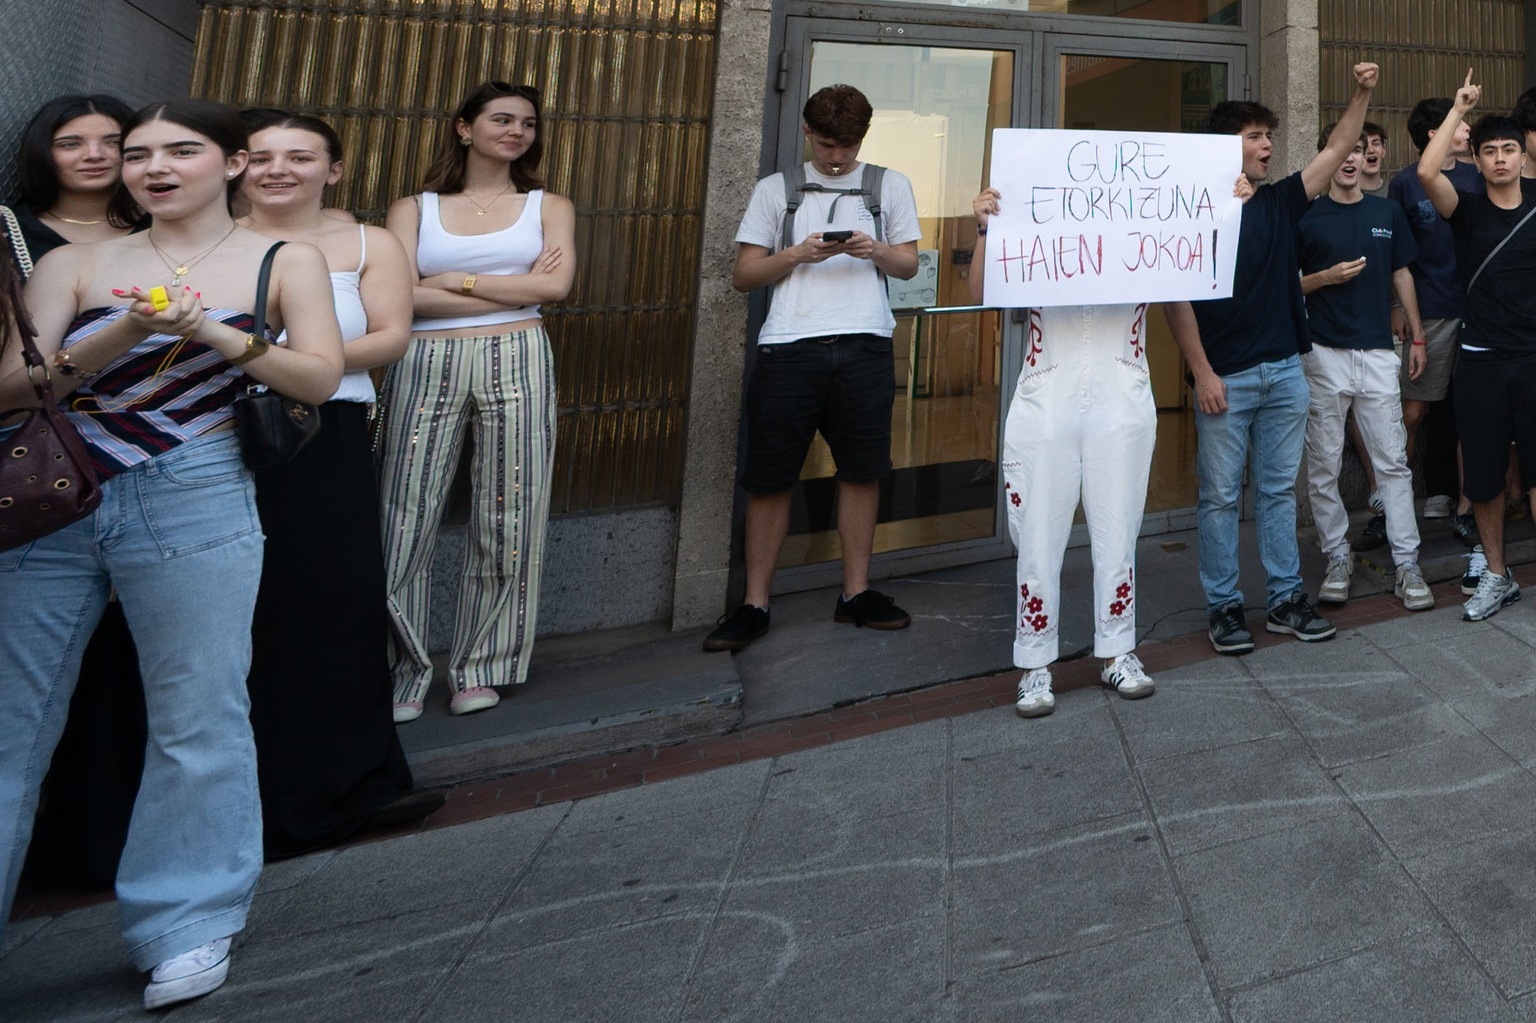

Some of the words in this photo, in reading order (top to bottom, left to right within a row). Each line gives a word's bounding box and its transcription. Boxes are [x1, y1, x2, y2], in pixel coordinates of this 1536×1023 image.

[1067, 140, 1170, 184] GURE
[1025, 182, 1216, 224] ETORKIZUNA
[996, 233, 1103, 283] HAIEN
[1121, 228, 1218, 290] JOKOA!
